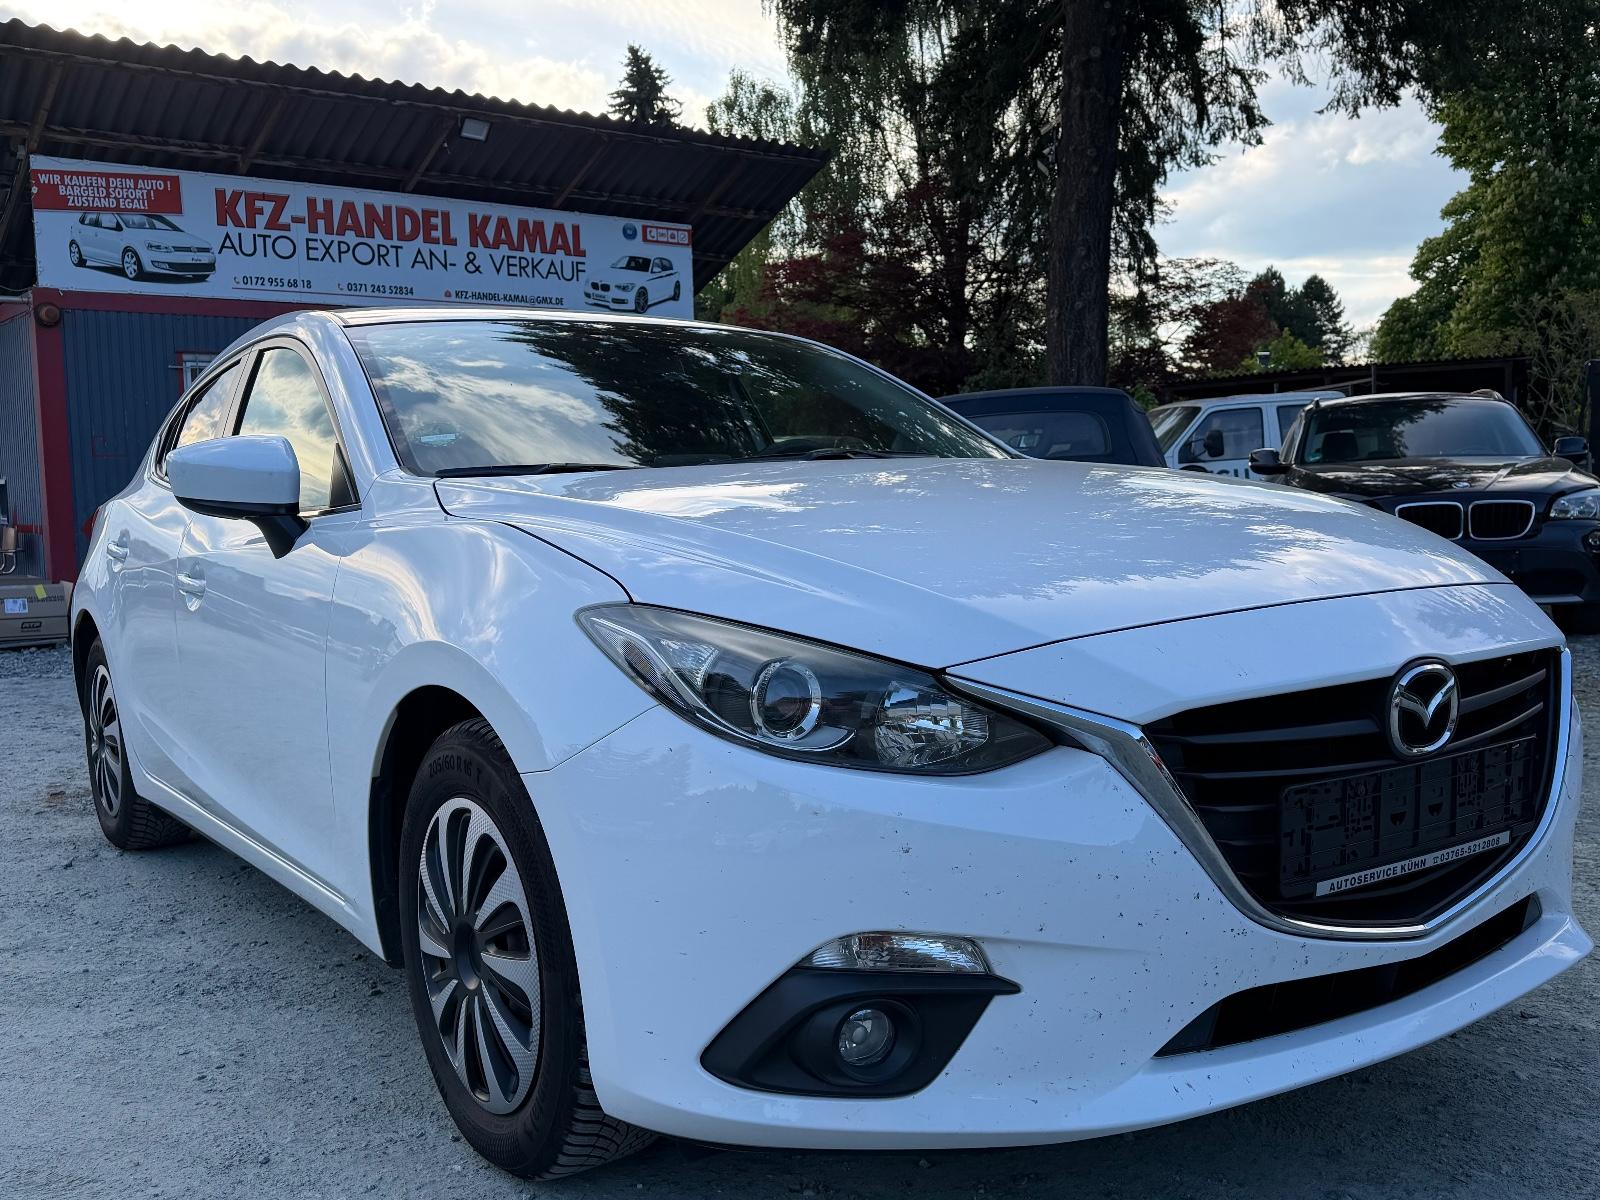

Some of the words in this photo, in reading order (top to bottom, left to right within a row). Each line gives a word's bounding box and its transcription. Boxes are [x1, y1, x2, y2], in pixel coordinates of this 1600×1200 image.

[38, 173, 61, 184] WIR
[64, 175, 106, 188] KAUFEN
[109, 178, 134, 189] DEIN
[137, 180, 164, 190] AUTO
[58, 185, 104, 197] BARGELD
[109, 188, 147, 199] SOFORT
[68, 196, 116, 208] ZUSTAND
[119, 199, 148, 209] EGAL!
[215, 188, 457, 246] KFZ-HANDEL
[468, 212, 586, 257] KAMAL
[218, 231, 297, 259] AUTO
[305, 238, 403, 268] EXPORT
[411, 248, 456, 271] AN-
[464, 251, 482, 274] &
[489, 254, 586, 282] VERKAUF
[242, 276, 265, 286] 0172
[268, 278, 285, 288] 955
[287, 279, 299, 288] 68
[301, 280, 312, 289] 18
[347, 282, 368, 292] 0371
[370, 284, 386, 294] 243
[388, 285, 414, 296] 52834
[455, 290, 564, 306] KFZ-HANDEL-KAMAL@GMX.DE
[1328, 866, 1398, 893] AUTOSERVICE
[1400, 858, 1427, 874] KÜHN
